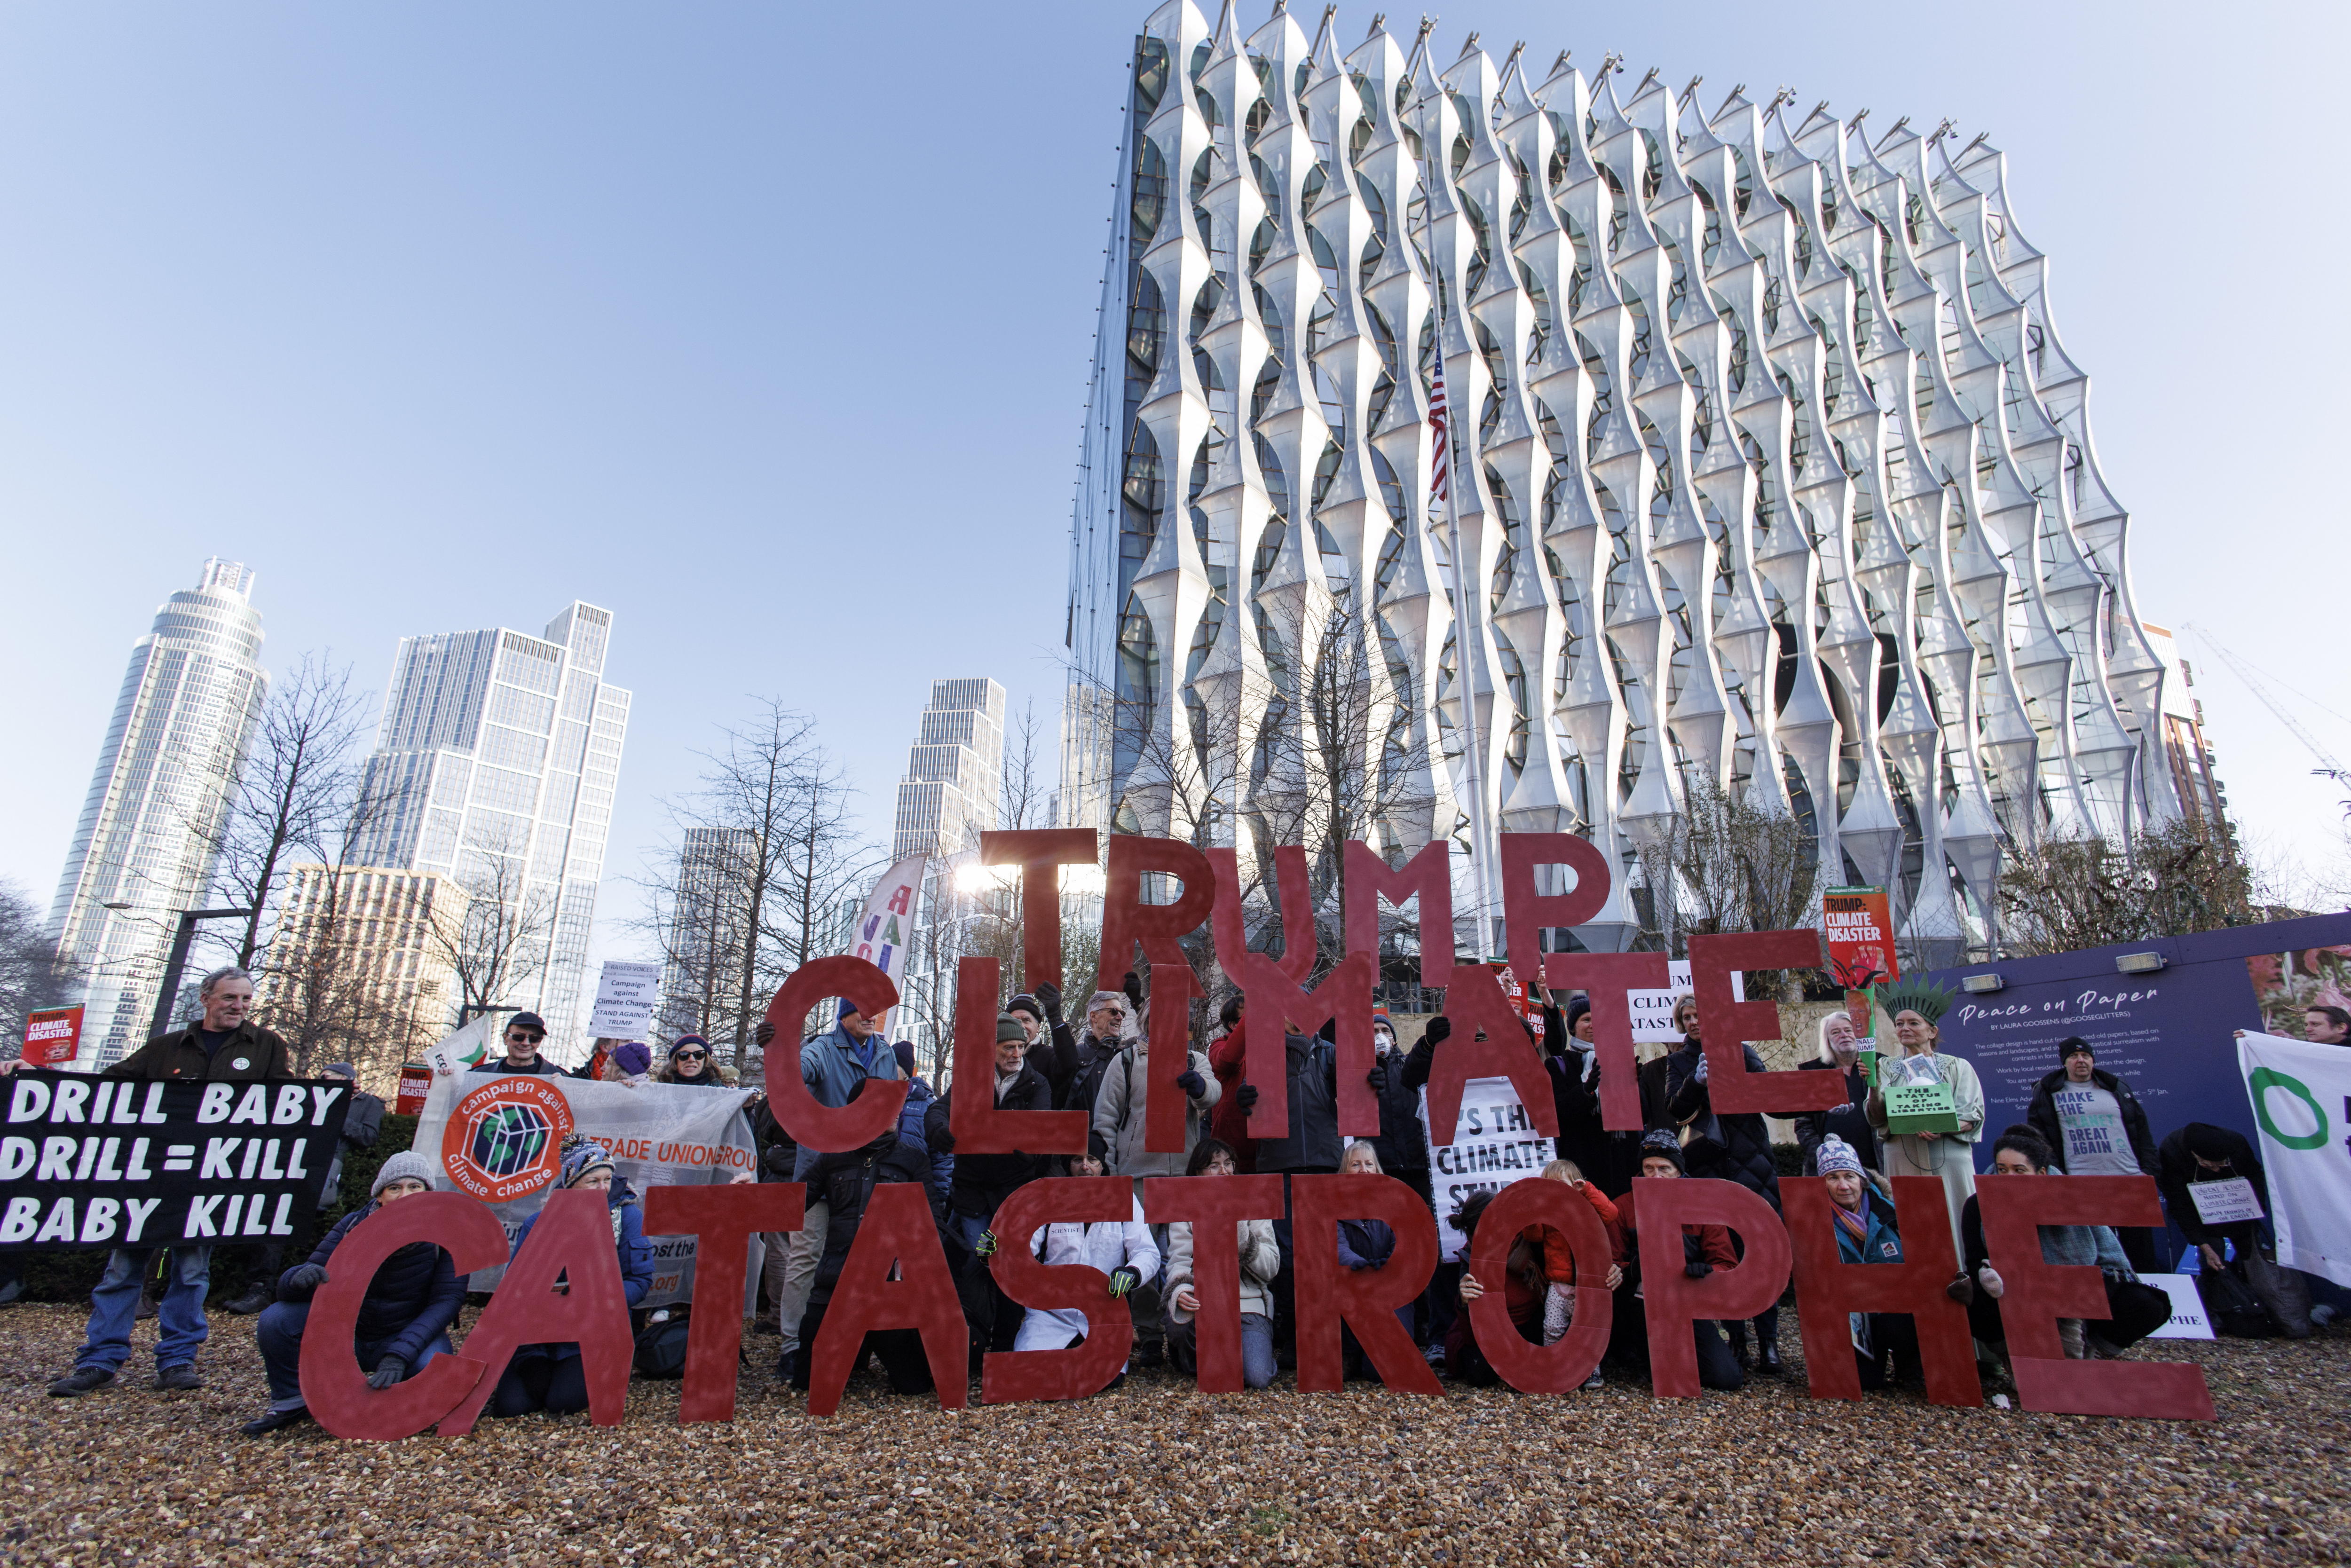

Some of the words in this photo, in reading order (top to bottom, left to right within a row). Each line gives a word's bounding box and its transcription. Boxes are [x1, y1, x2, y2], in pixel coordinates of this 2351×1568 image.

[1825, 898, 1866, 911] TRUMP:
[980, 828, 1611, 997] TRUMP
[1826, 912, 1872, 927] CLIMATE
[1828, 927, 1881, 942] DISASTER
[611, 980, 646, 988] Campaign
[1633, 997, 1677, 1008] CLIM
[1958, 1003, 2032, 1026] Peace
[2043, 999, 2066, 1012] on
[2076, 989, 2158, 1014] Paper
[30, 1019, 70, 1032] CLIMATE
[1528, 1013, 1544, 1025] LIMA
[2023, 1018, 2060, 1027] GOOSSENS
[2061, 1011, 2130, 1024] (@GOOSEGLITTERS)
[28, 1028, 73, 1041] DISASTER
[764, 929, 1849, 1153] CLIMATE
[401, 1078, 429, 1088] CLIMATE
[400, 1087, 428, 1097] DISASTE
[2056, 1092, 2094, 1104] MAKE
[8, 1079, 167, 1124] DRILL
[197, 1083, 343, 1126] BABY
[462, 1080, 535, 1114] campaign
[537, 1089, 569, 1131] against
[2059, 1103, 2085, 1116] THE
[1458, 1108, 1483, 1135] 'S
[1490, 1104, 1536, 1133] TH
[2065, 1114, 2114, 1128] PLANET
[2068, 1127, 2108, 1142] GREAT
[590, 1136, 652, 1160] TRADE
[658, 1142, 718, 1166] UNION
[714, 1145, 757, 1172] GROU
[2073, 1141, 2112, 1155] AGAIN
[1437, 1139, 1550, 1175] CLIMATE
[449, 1154, 488, 1196] climate
[497, 1168, 552, 1197] change
[2194, 1185, 2219, 1195] URGENT
[2226, 1196, 2251, 1205] CHANGE
[0, 1198, 161, 1243] BABY
[184, 1194, 293, 1237] KILL
[676, 1239, 695, 1256] the
[299, 1173, 2218, 1442] CATASTROPHE
